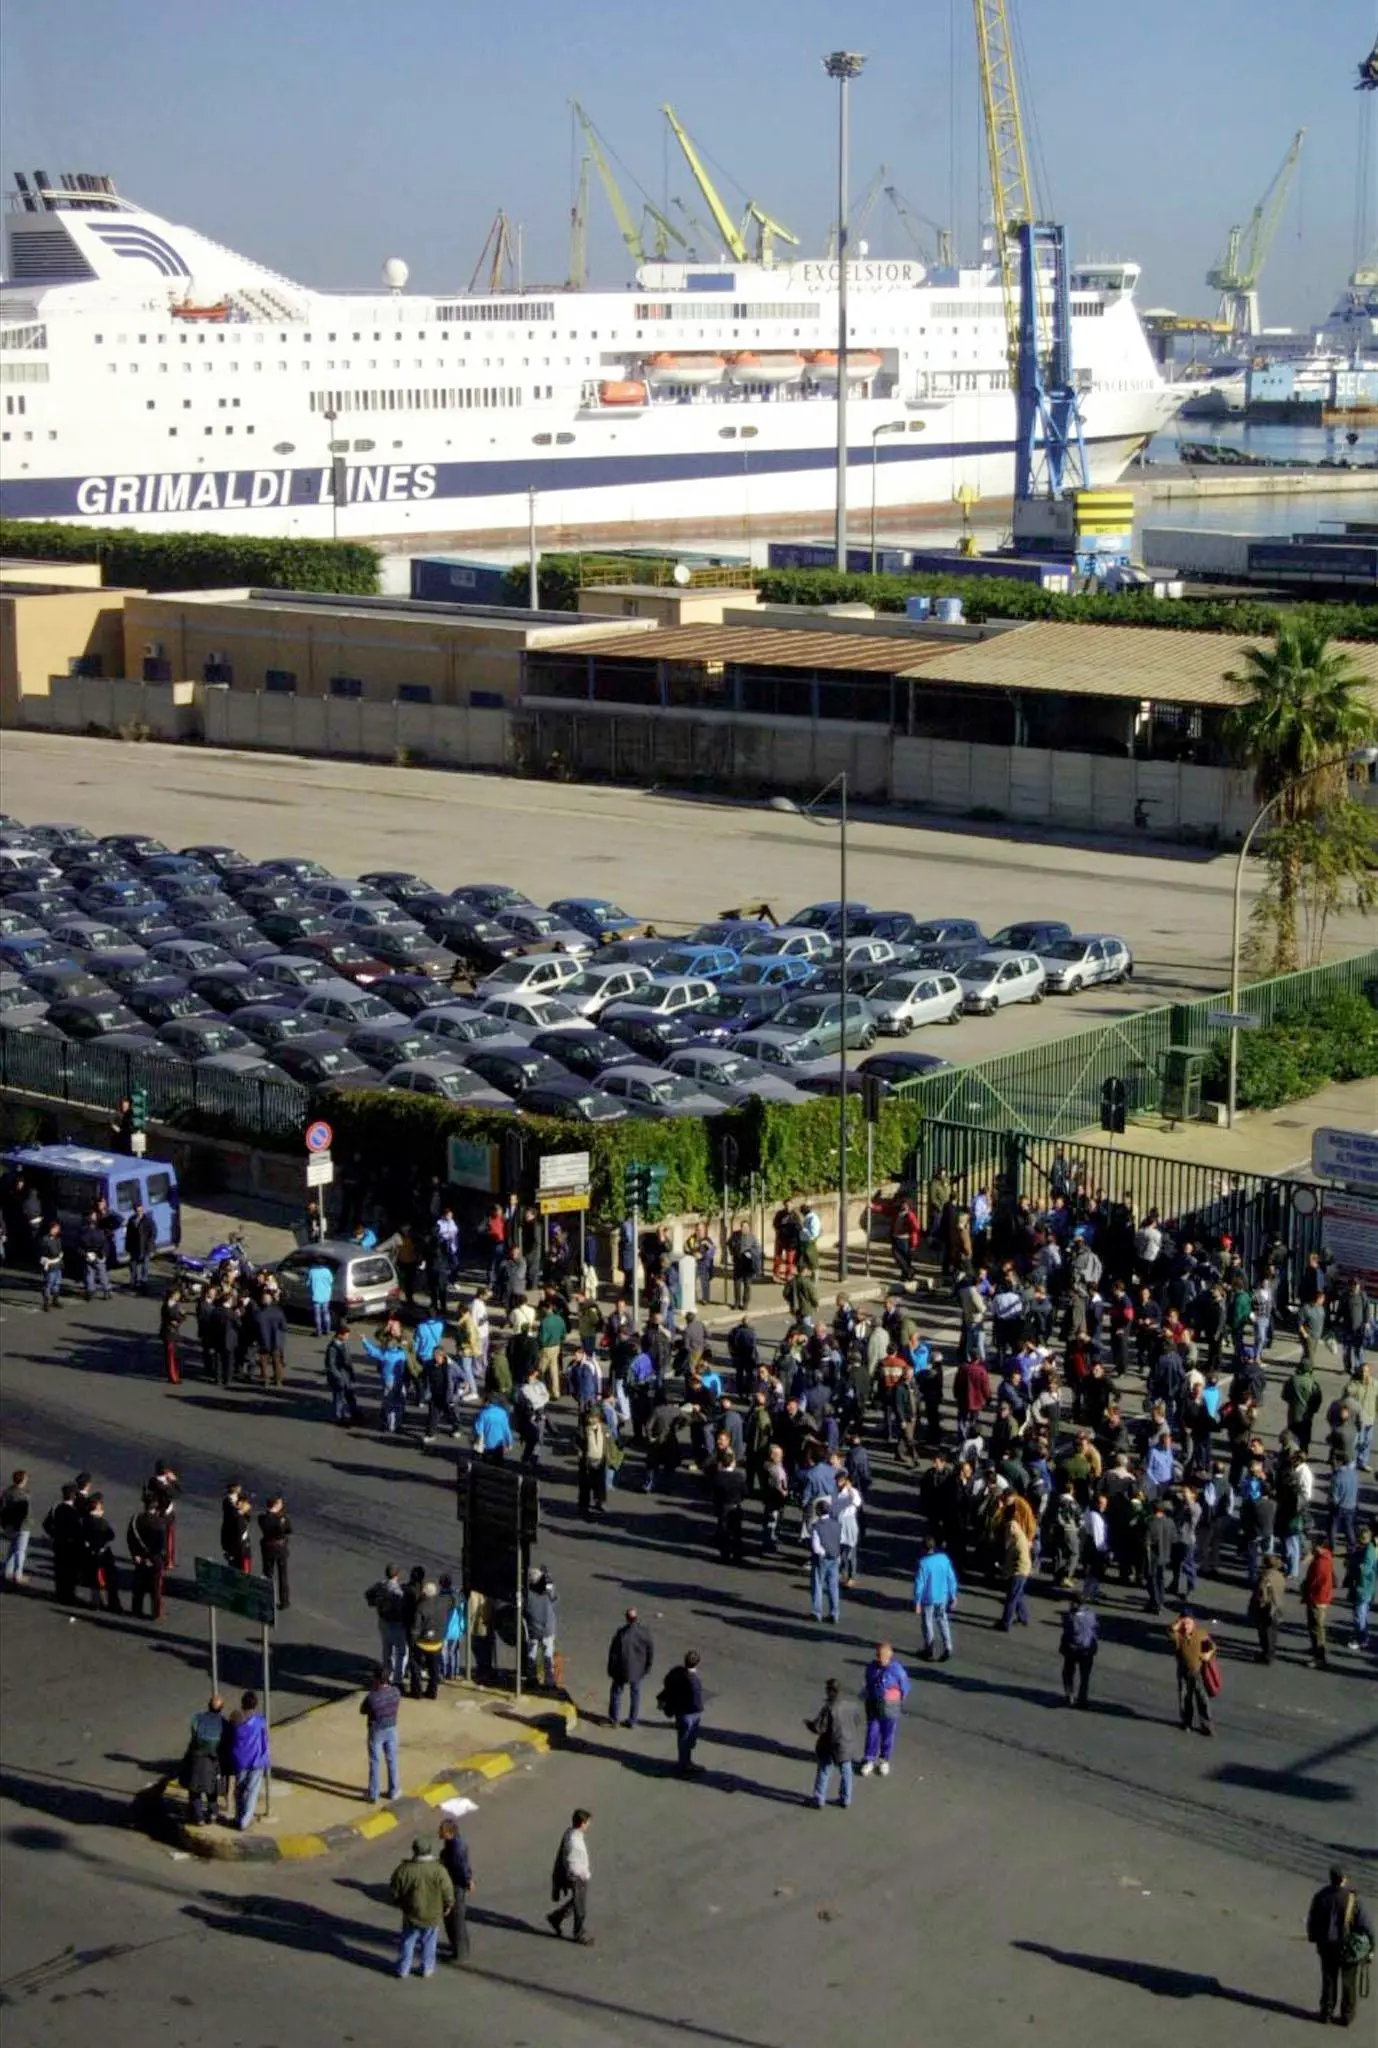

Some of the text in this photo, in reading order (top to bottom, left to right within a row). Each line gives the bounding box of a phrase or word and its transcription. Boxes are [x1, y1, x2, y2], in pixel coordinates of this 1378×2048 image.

[803, 263, 912, 281] EXCELSIOR
[77, 464, 437, 514] GRIMALDI LINES
